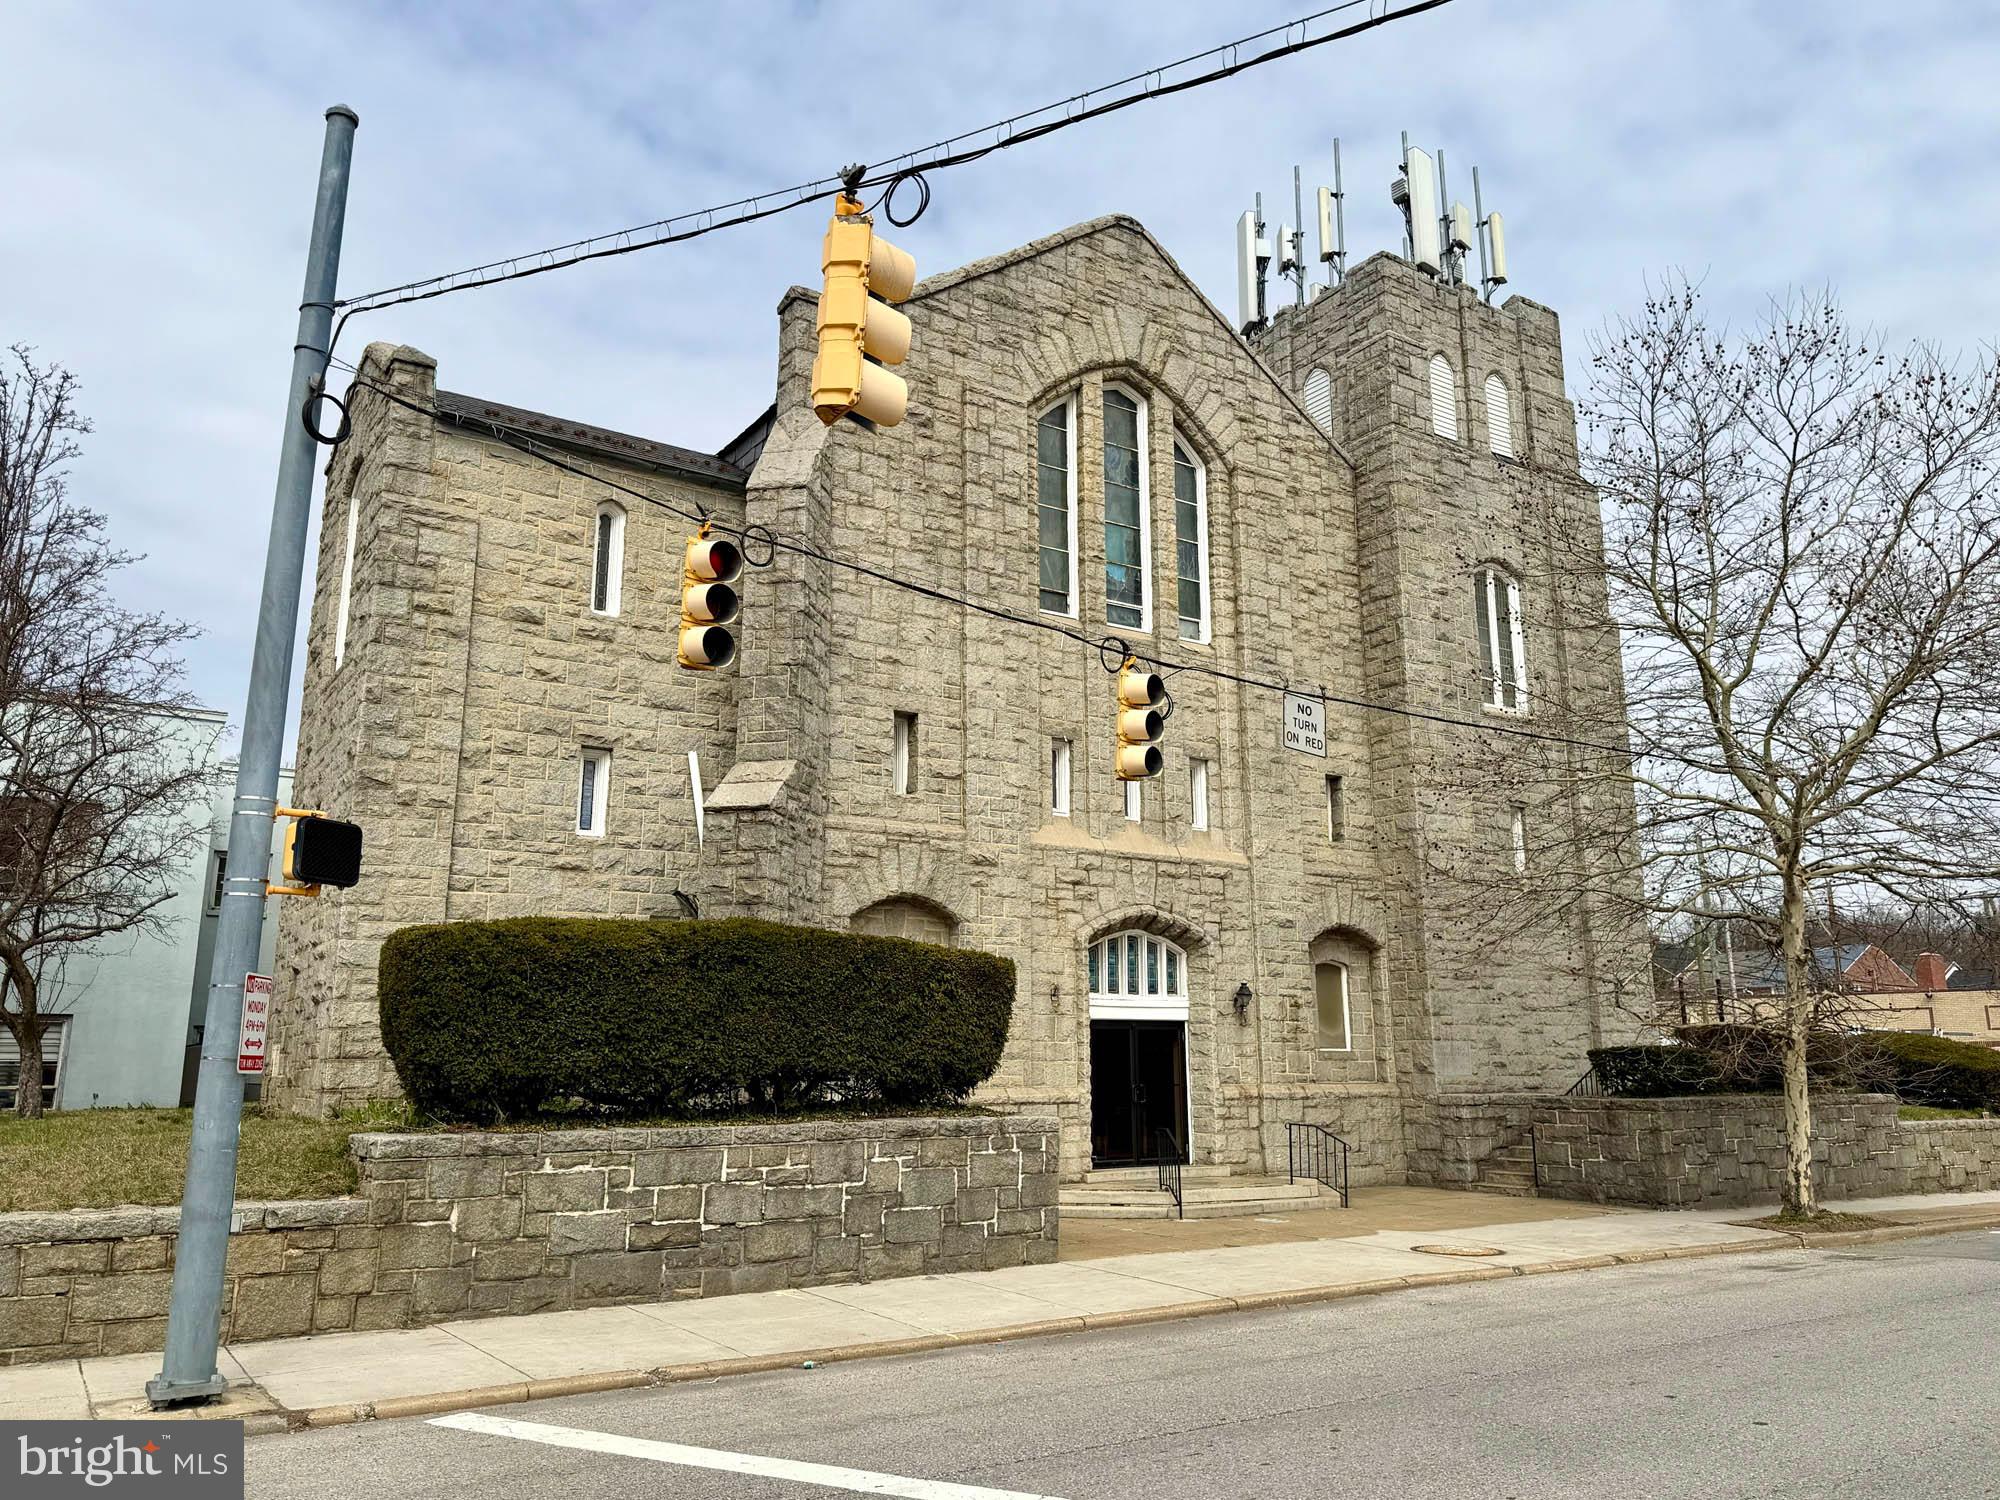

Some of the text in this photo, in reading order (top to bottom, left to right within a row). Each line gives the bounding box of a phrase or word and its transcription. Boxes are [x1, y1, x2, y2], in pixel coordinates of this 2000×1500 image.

[1297, 703, 1312, 716] NO
[1293, 717, 1317, 733] TURN
[1286, 731, 1323, 750] ON RED
[247, 1000, 267, 1013] MONDAY
